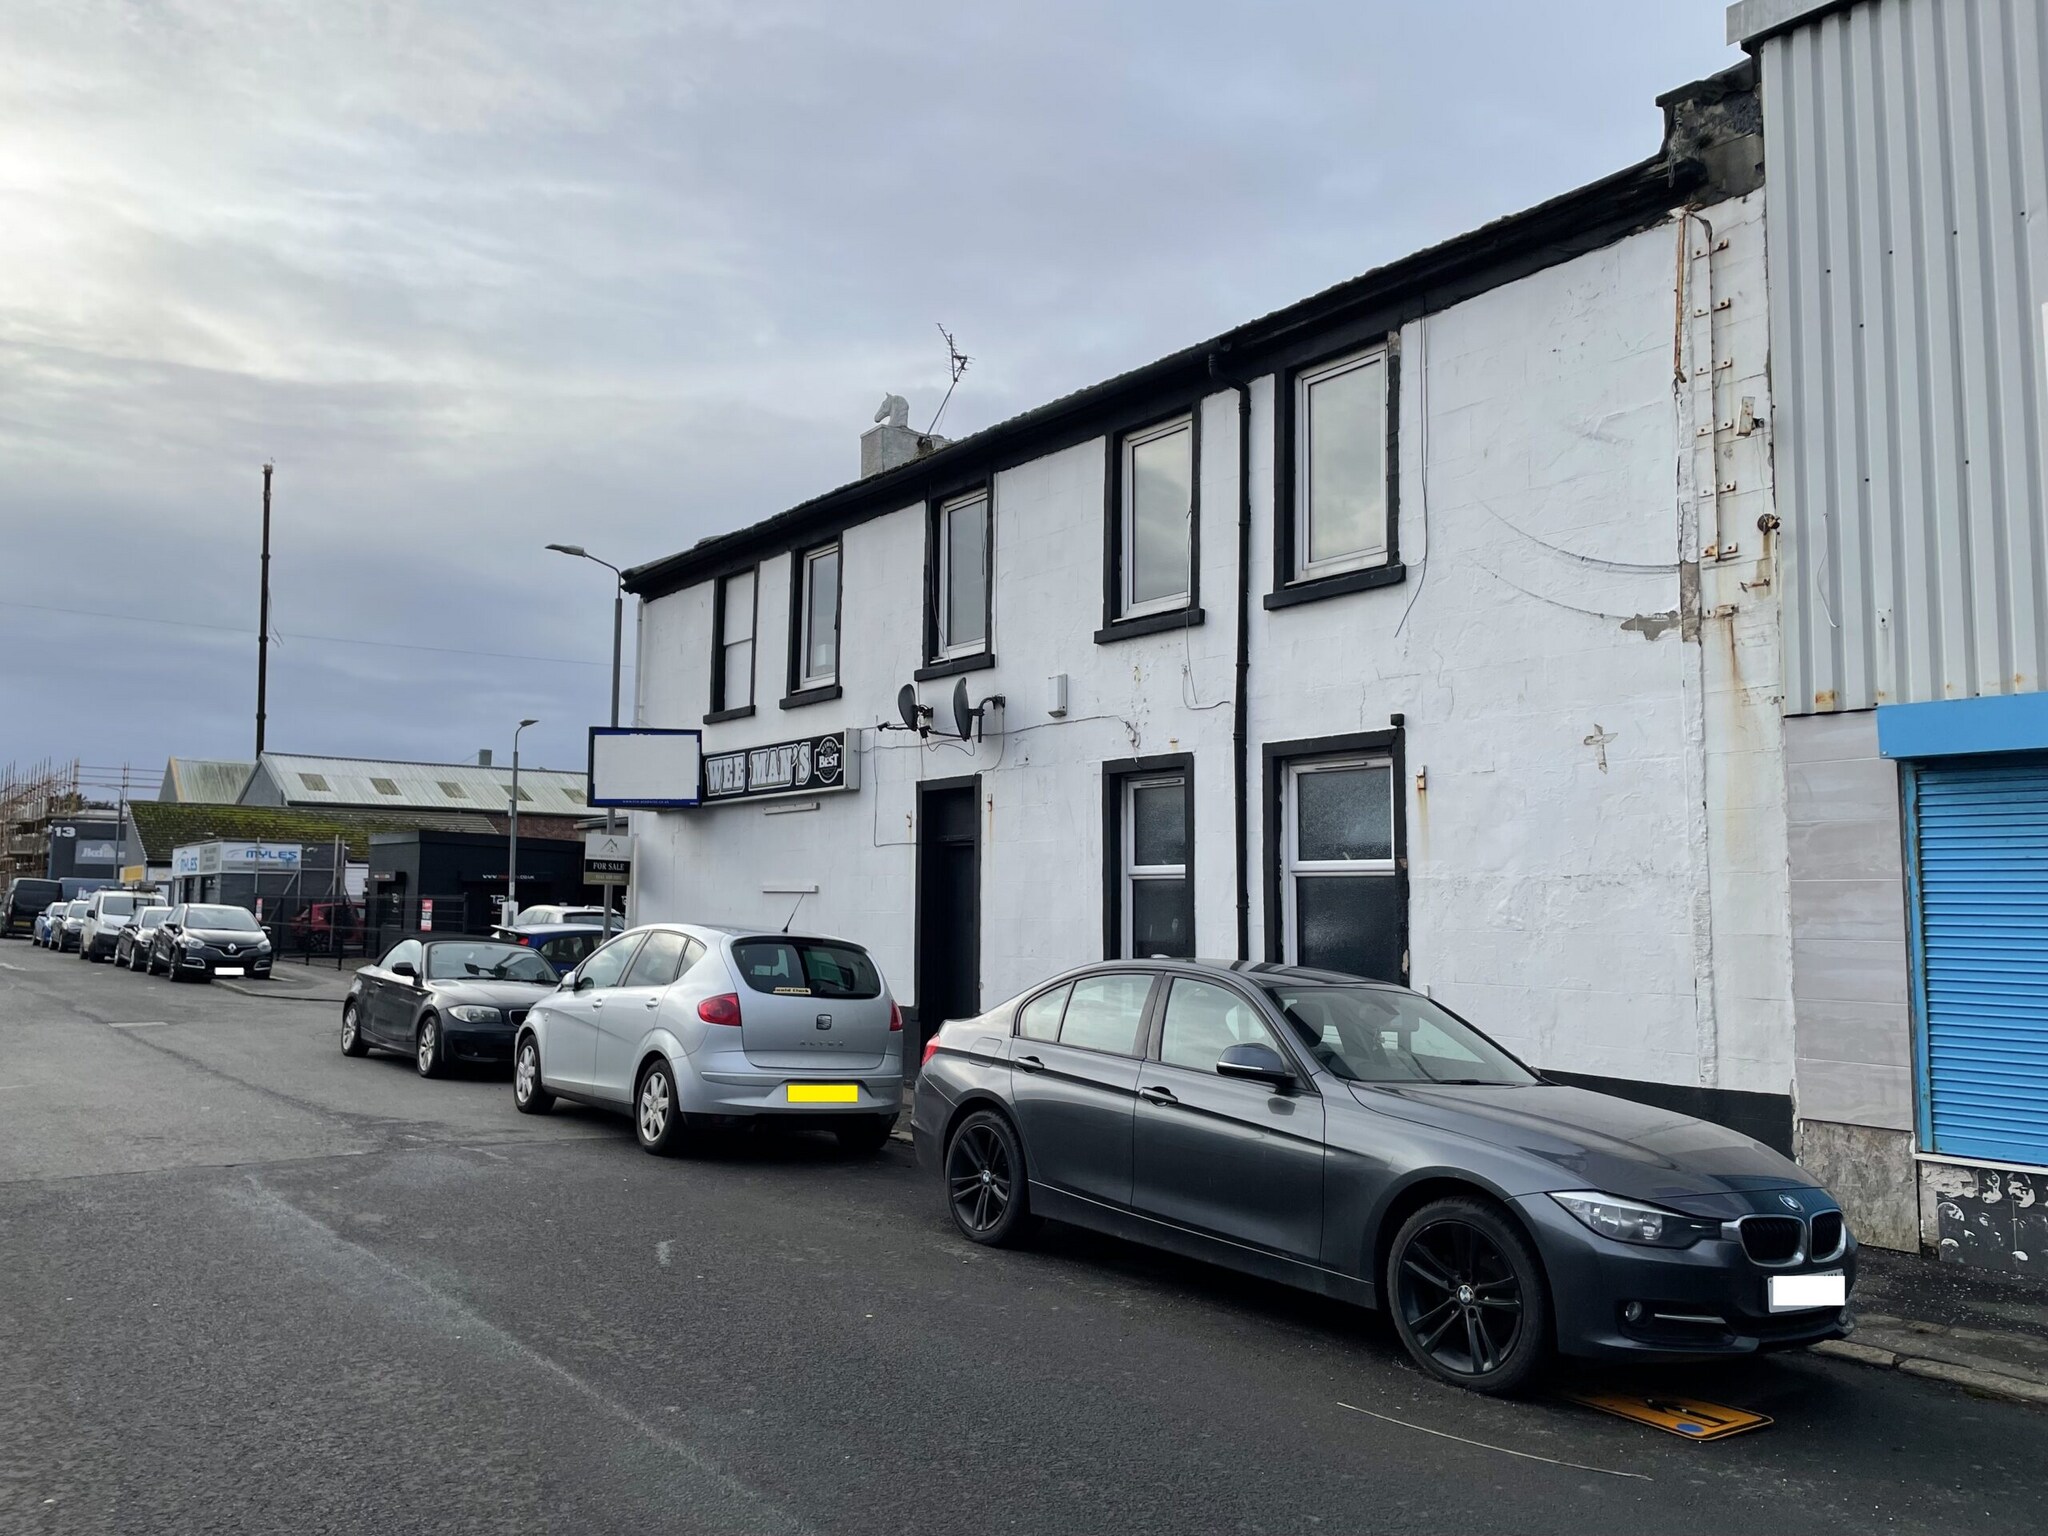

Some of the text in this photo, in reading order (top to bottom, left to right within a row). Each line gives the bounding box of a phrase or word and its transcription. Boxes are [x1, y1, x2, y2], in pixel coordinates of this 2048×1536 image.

[818, 753, 839, 768] BEST
[707, 744, 810, 793] WEE MAN'S
[54, 826, 76, 838] 13
[245, 850, 297, 860] MYLES
[593, 862, 625, 871] FOR SALE
